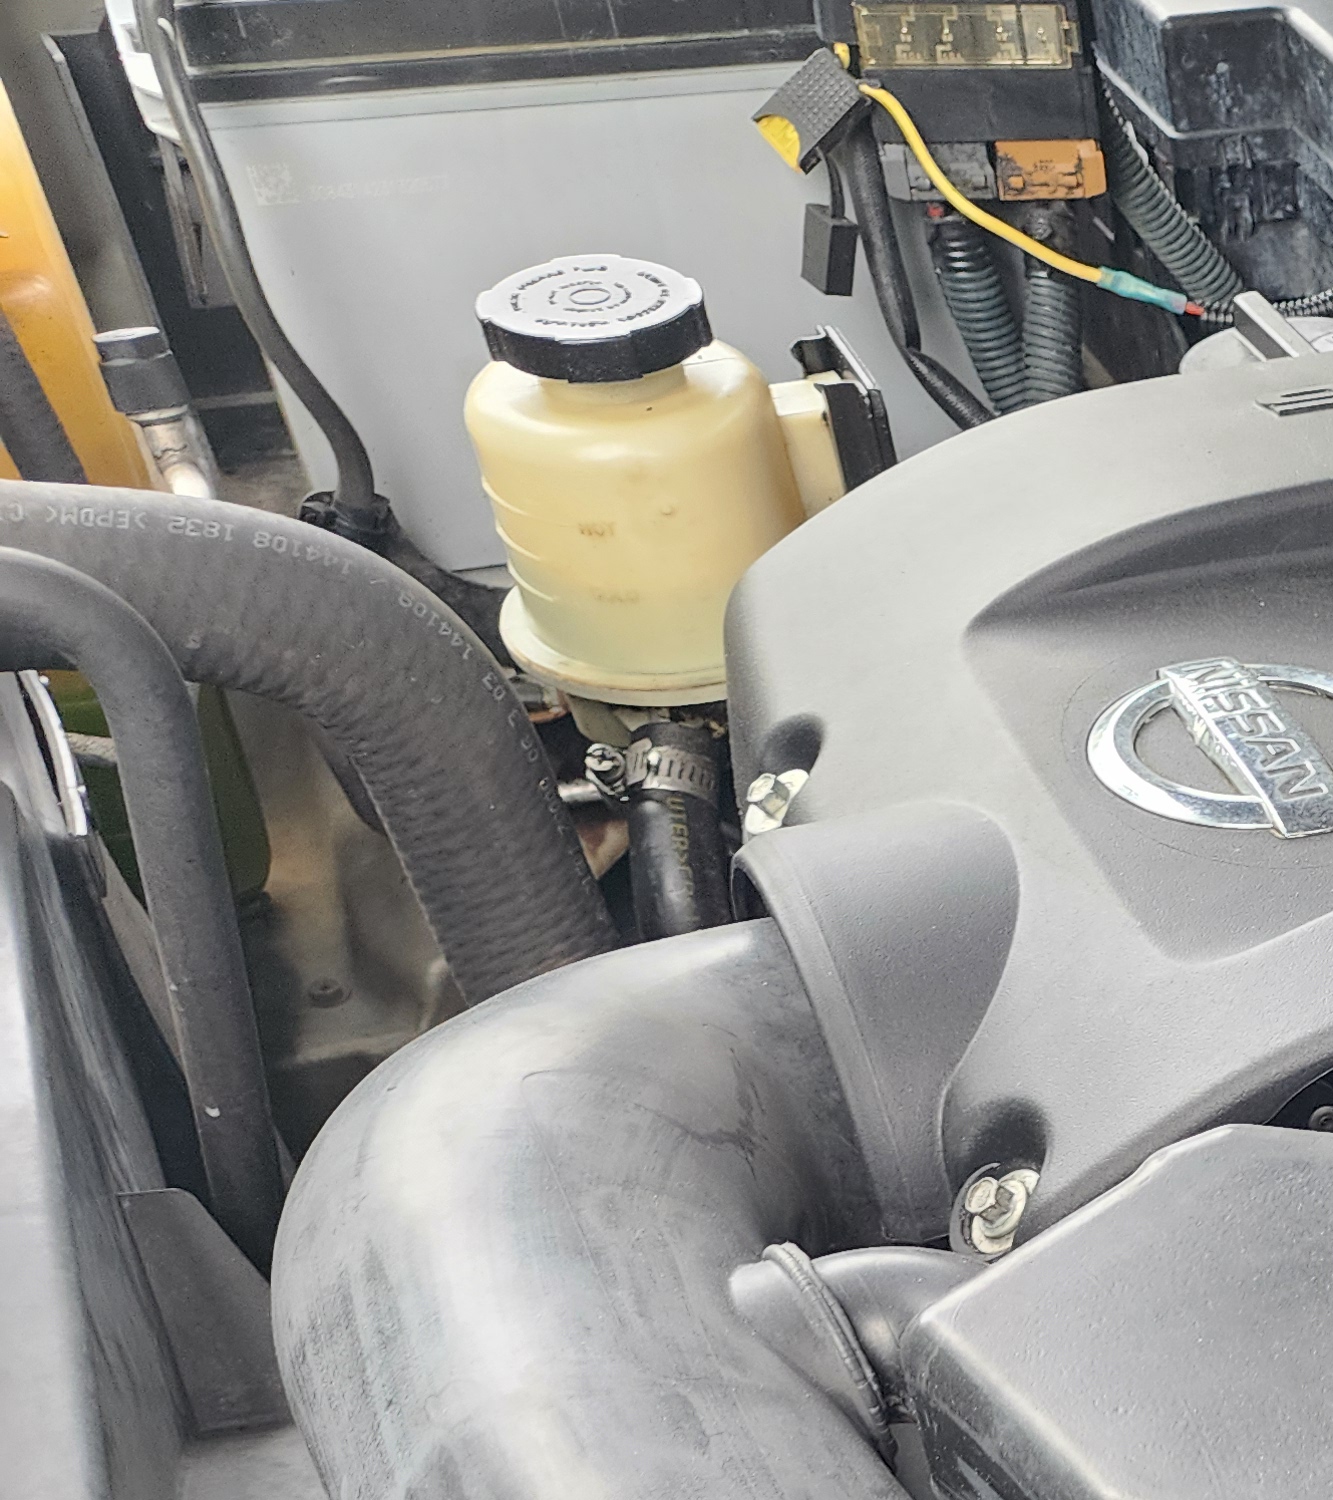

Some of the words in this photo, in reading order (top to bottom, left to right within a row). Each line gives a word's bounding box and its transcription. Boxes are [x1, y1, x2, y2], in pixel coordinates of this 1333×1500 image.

[46, 504, 148, 530] >EPDM<
[167, 515, 235, 542] 1832
[1176, 659, 1329, 802] NISSAN
